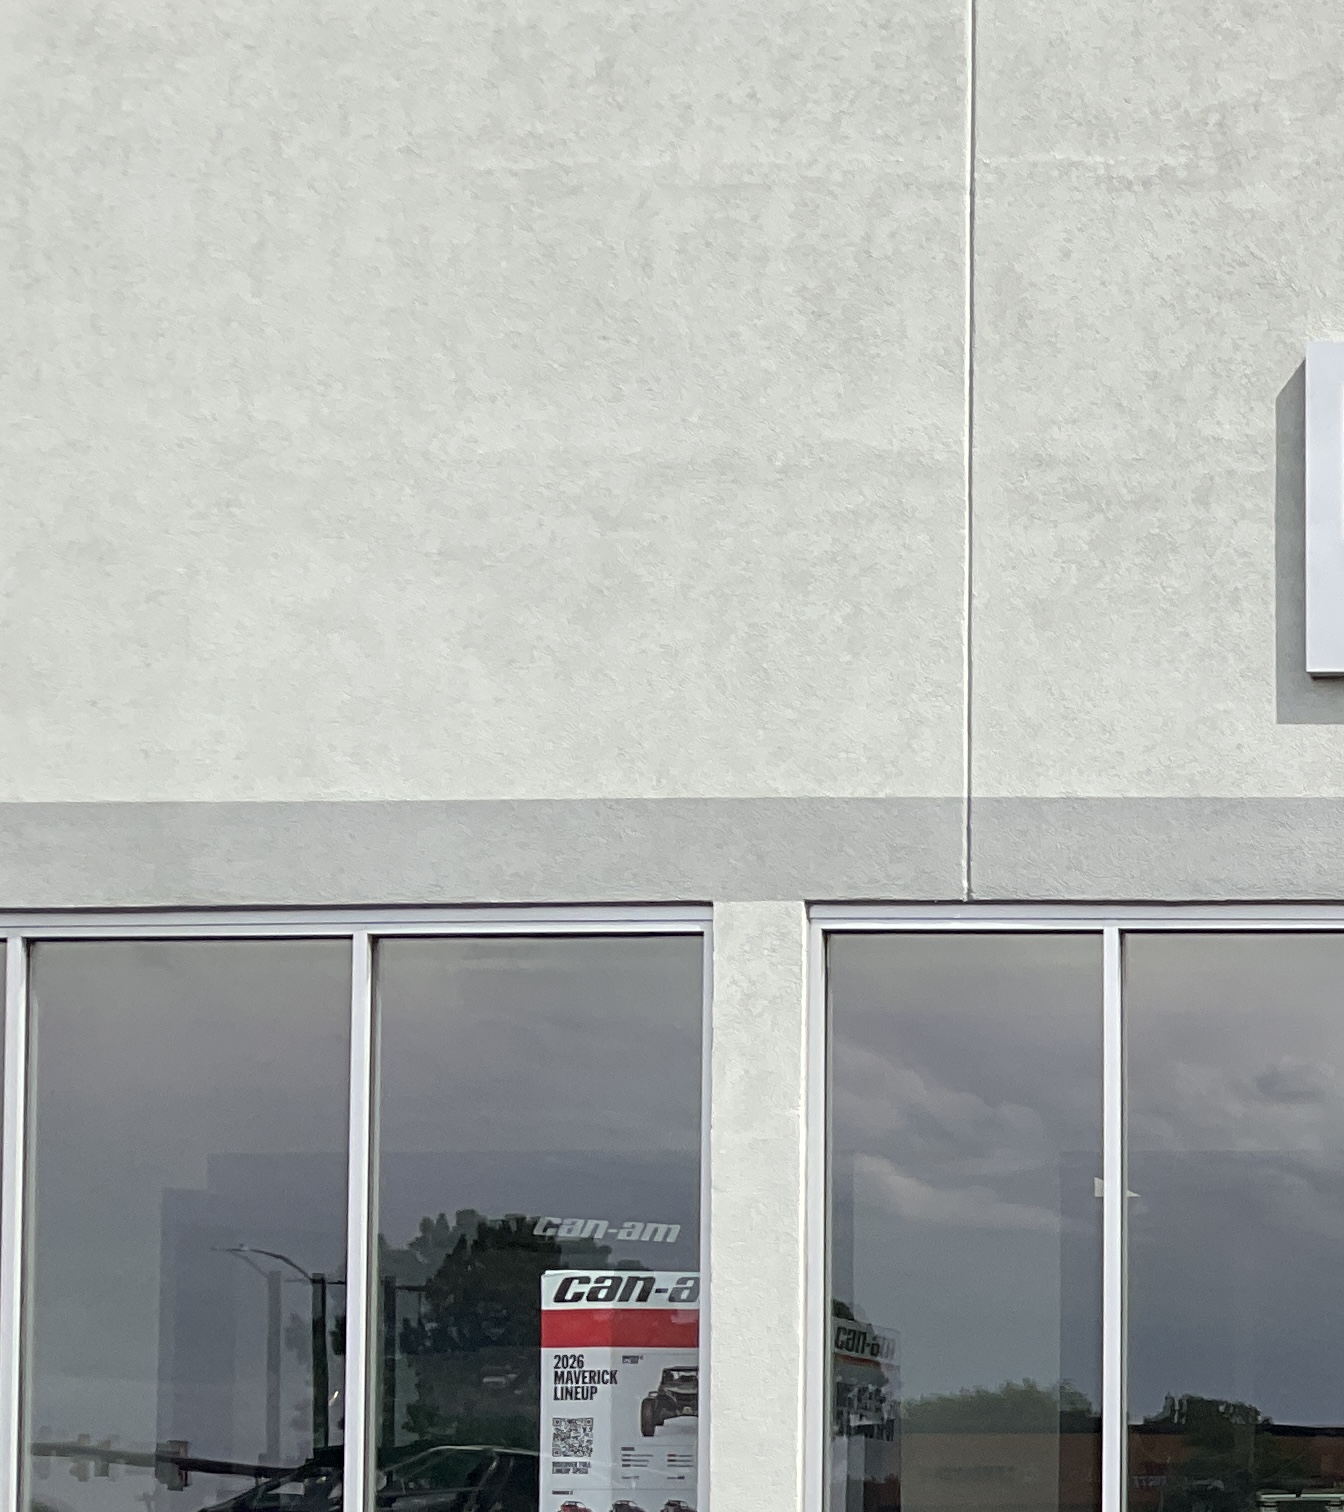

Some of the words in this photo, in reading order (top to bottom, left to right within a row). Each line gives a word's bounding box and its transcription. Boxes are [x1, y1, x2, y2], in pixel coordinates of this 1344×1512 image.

[533, 1216, 681, 1243] can-am
[553, 1276, 699, 1303] can-a
[553, 1354, 585, 1369] 2026
[553, 1370, 618, 1385] MAVERICK
[553, 1386, 598, 1401] LINEUP
